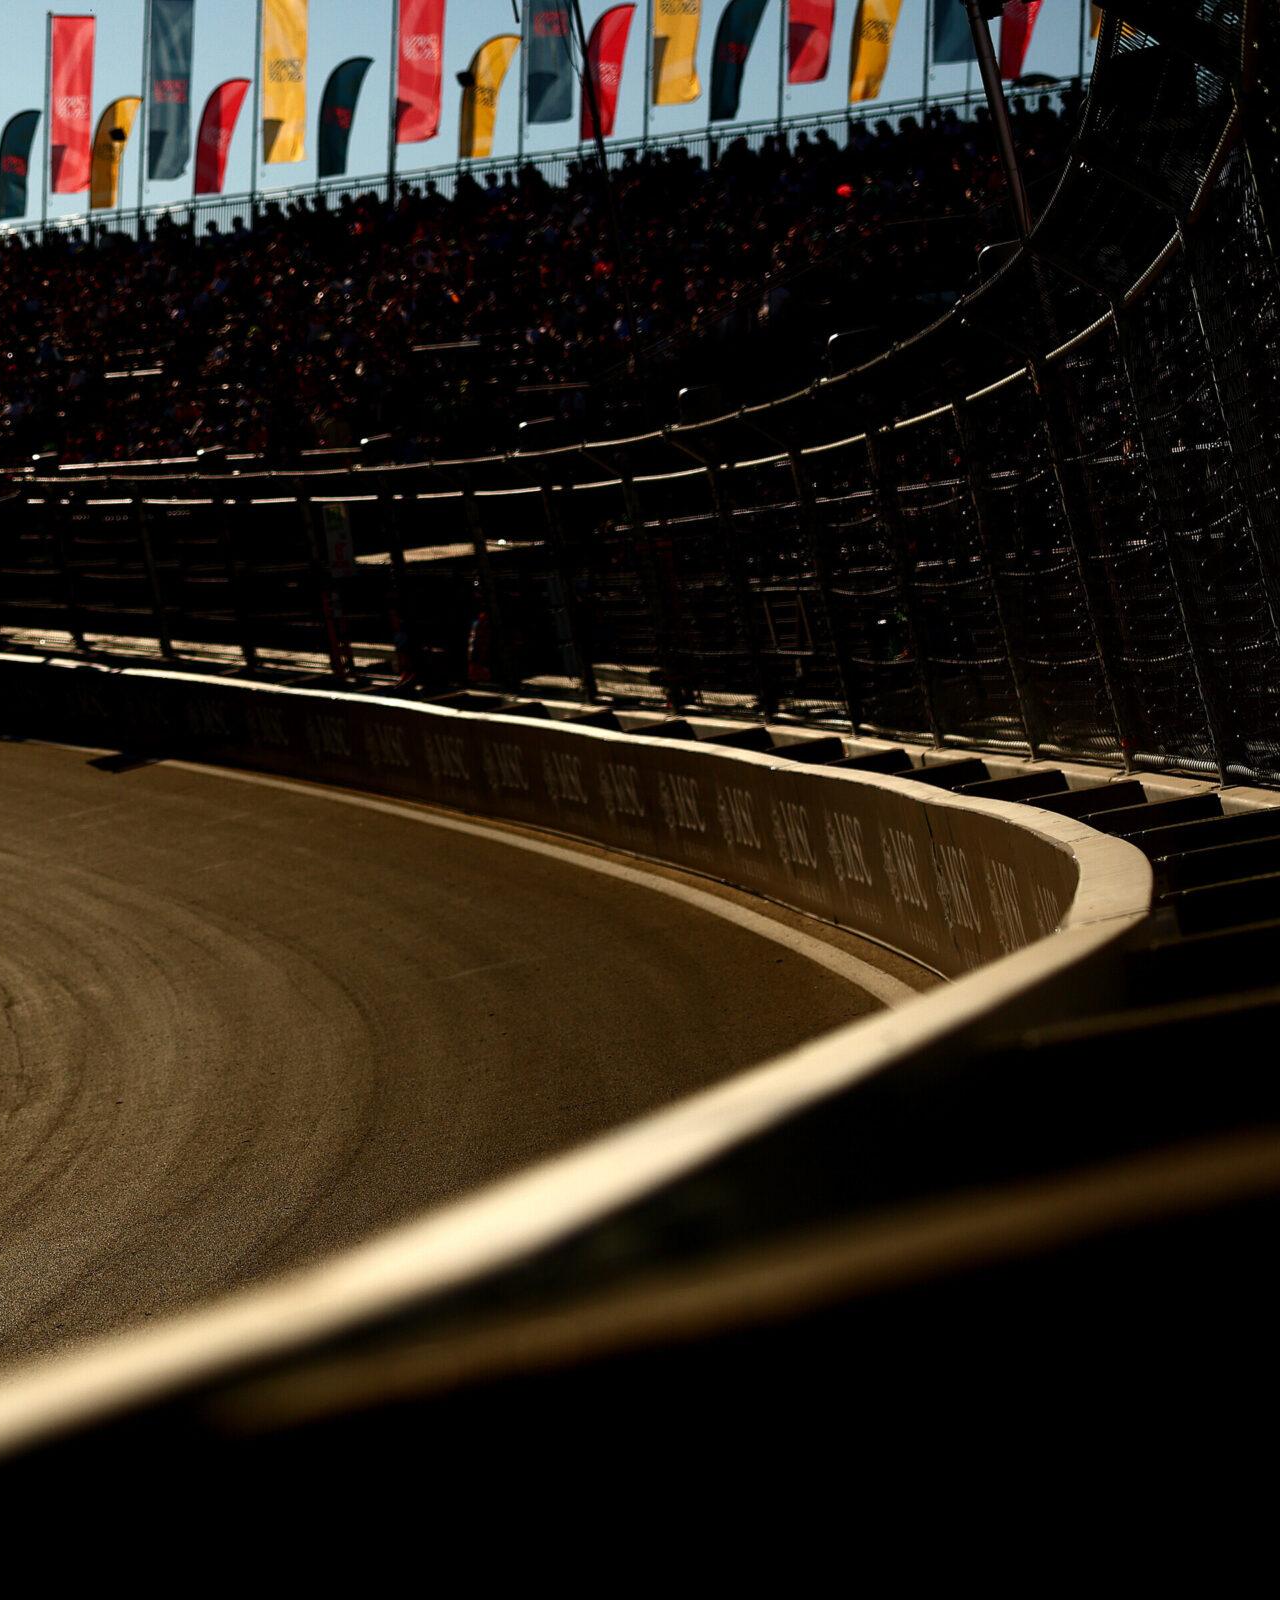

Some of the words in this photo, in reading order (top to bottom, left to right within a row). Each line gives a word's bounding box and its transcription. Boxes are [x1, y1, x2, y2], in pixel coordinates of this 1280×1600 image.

[668, 773, 707, 833] MSC
[726, 786, 762, 851] MSC
[779, 799, 817, 870] MSC
[833, 811, 873, 888] MSC
[888, 827, 928, 912] MSC
